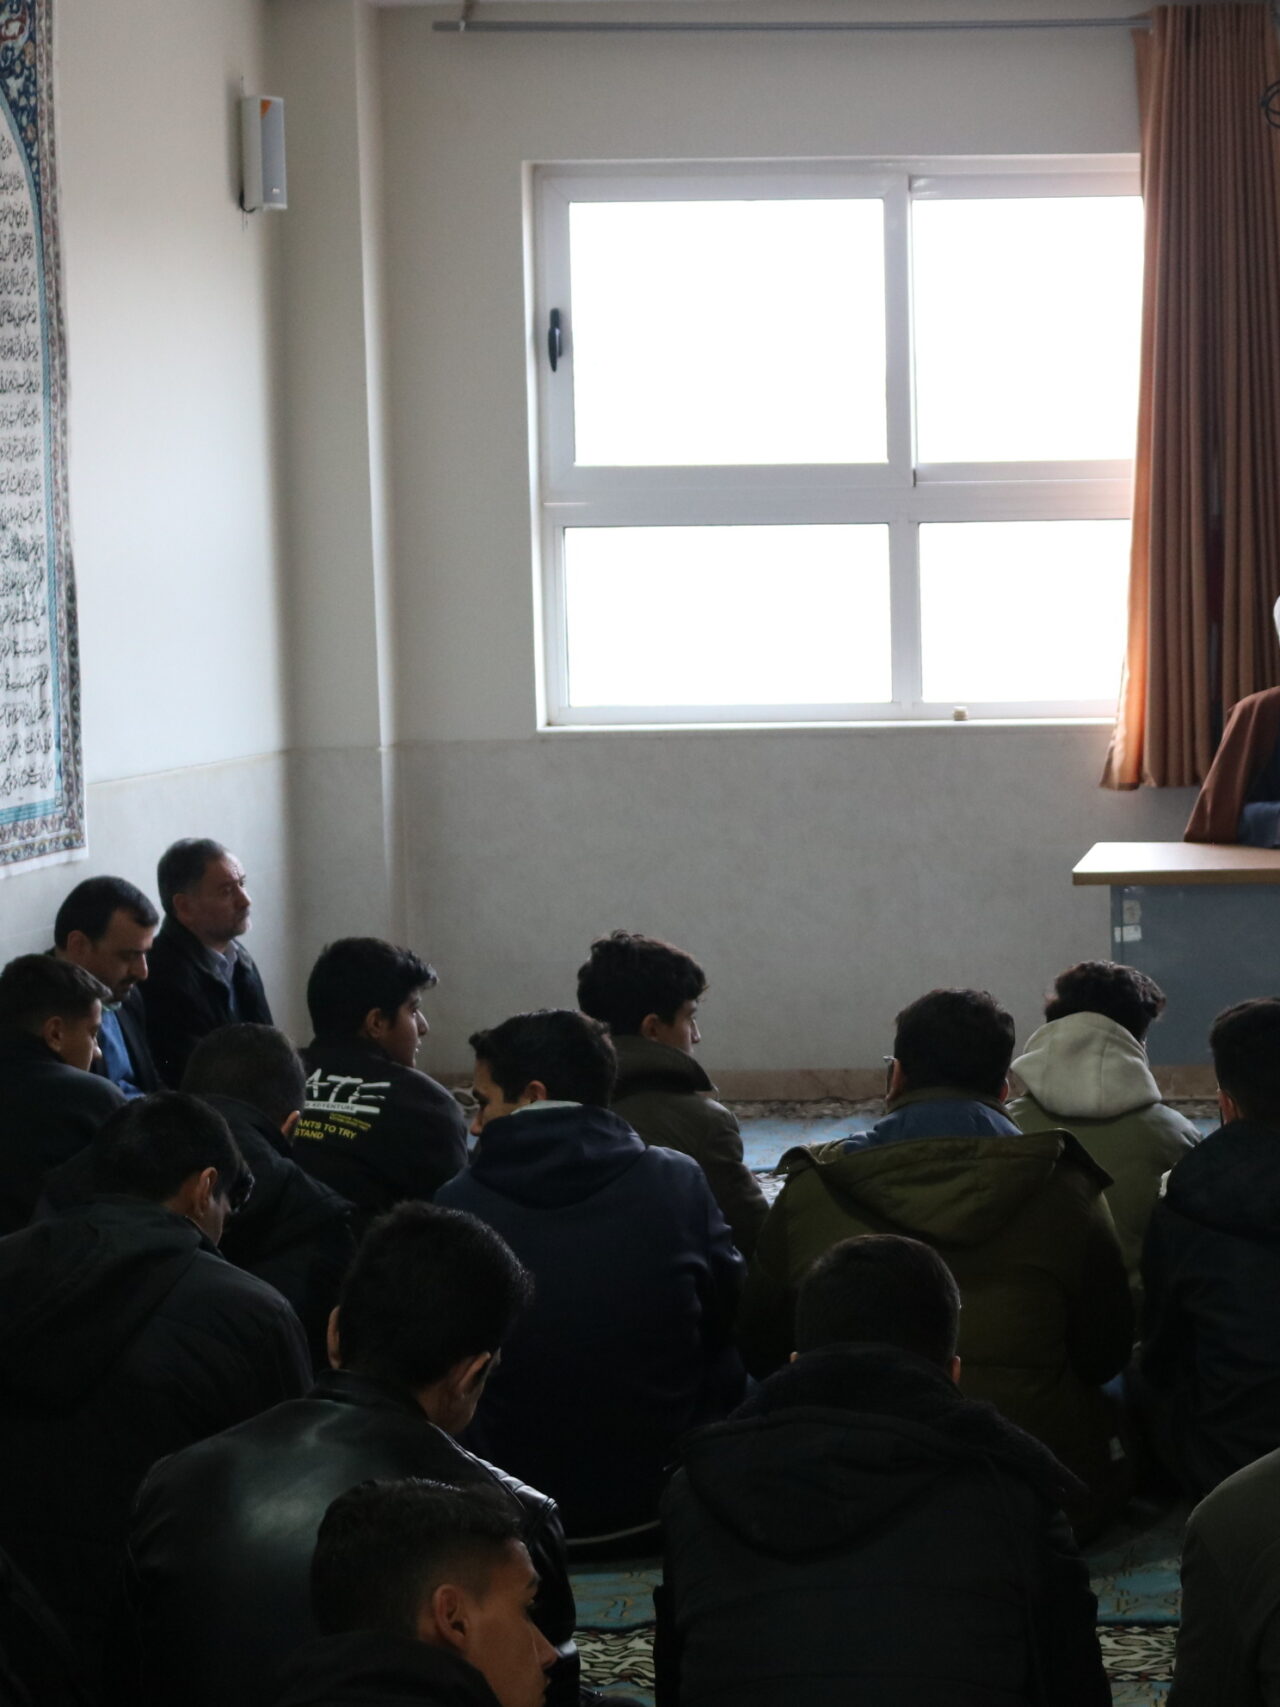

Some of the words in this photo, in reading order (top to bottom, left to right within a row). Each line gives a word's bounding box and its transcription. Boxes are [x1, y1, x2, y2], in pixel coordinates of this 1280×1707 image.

[299, 1119, 322, 1130] ANTS
[324, 1123, 337, 1133] TO
[338, 1127, 357, 1140] TRY
